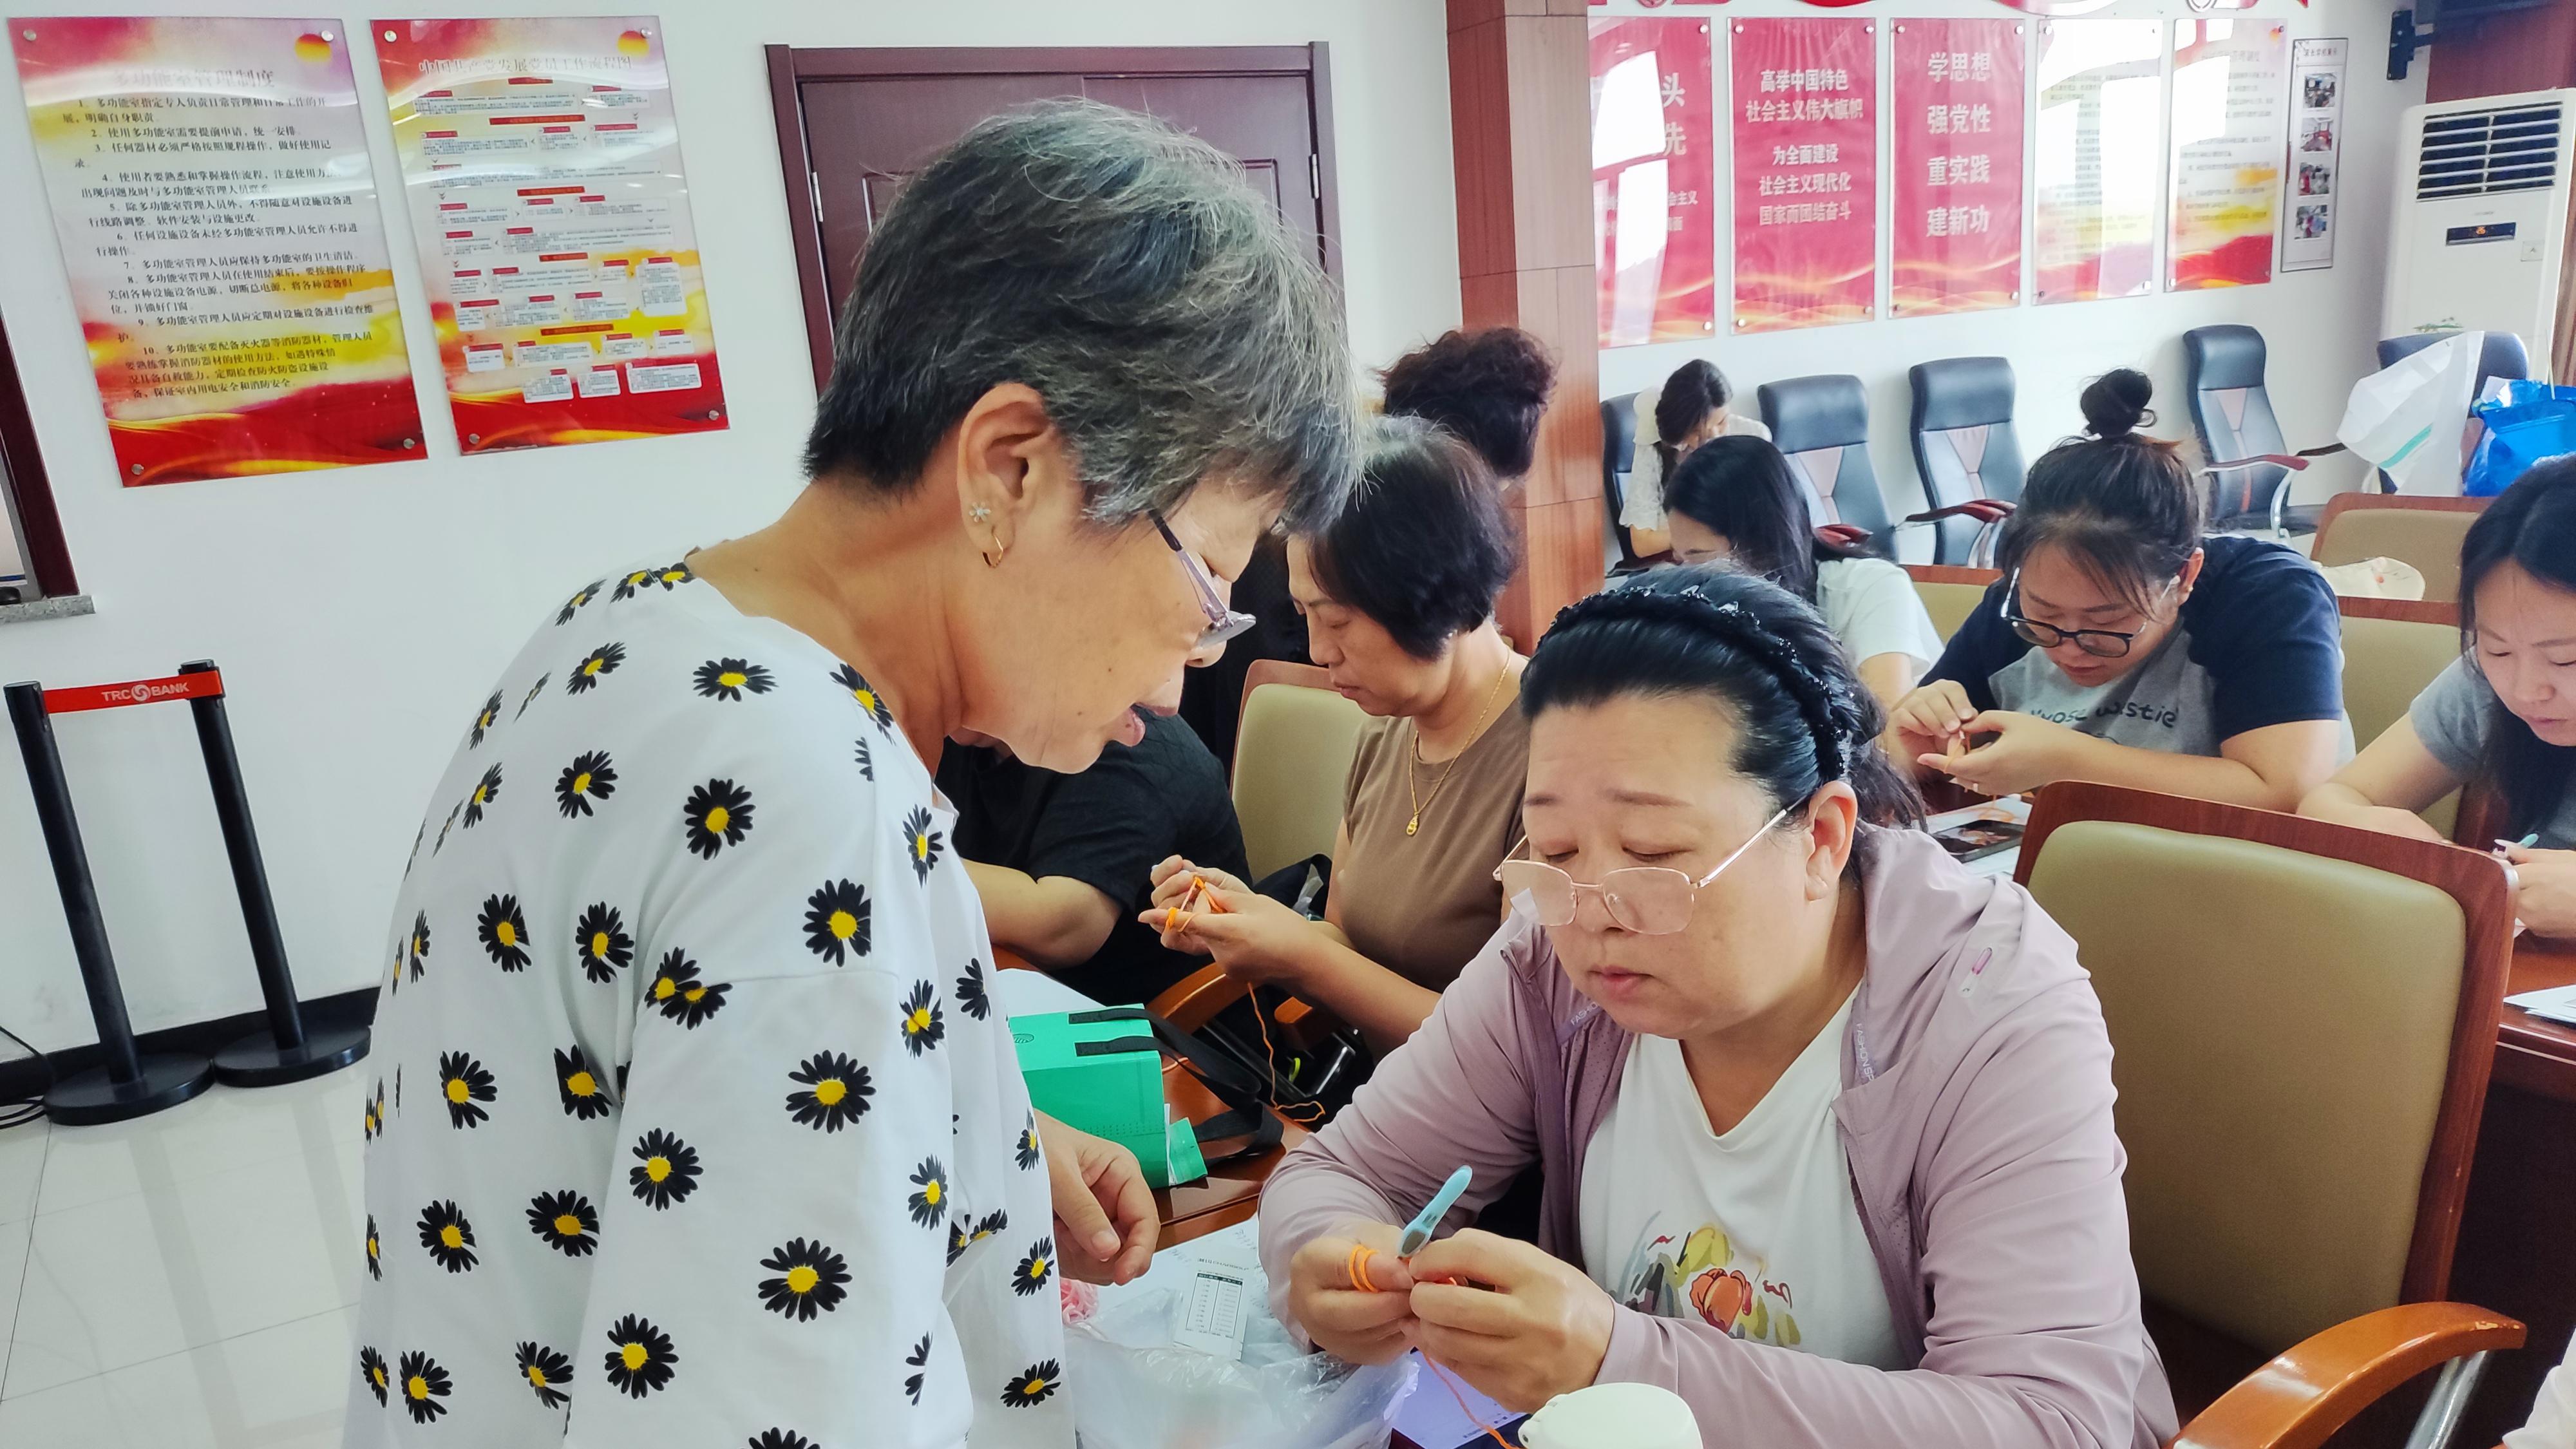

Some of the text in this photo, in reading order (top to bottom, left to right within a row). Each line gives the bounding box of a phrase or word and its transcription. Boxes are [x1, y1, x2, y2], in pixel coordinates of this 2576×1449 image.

[114, 70, 275, 88] 多功能室管理制度
[1927, 52, 1991, 82] 学思想
[1660, 72, 1686, 108] 头
[1760, 68, 1850, 93] 高举中国特色
[1745, 98, 1863, 123] 社会主义伟大旗帜
[1927, 103, 1991, 134] 强党性
[1772, 143, 1839, 166] 为全面建设
[1927, 155, 1991, 186] 重实践
[1759, 171, 1852, 196] 社会主义现代化
[1759, 201, 1852, 225] 国家而团结奋斗
[1926, 204, 1990, 237] 建新功
[101, 682, 189, 701] TRC BANK
